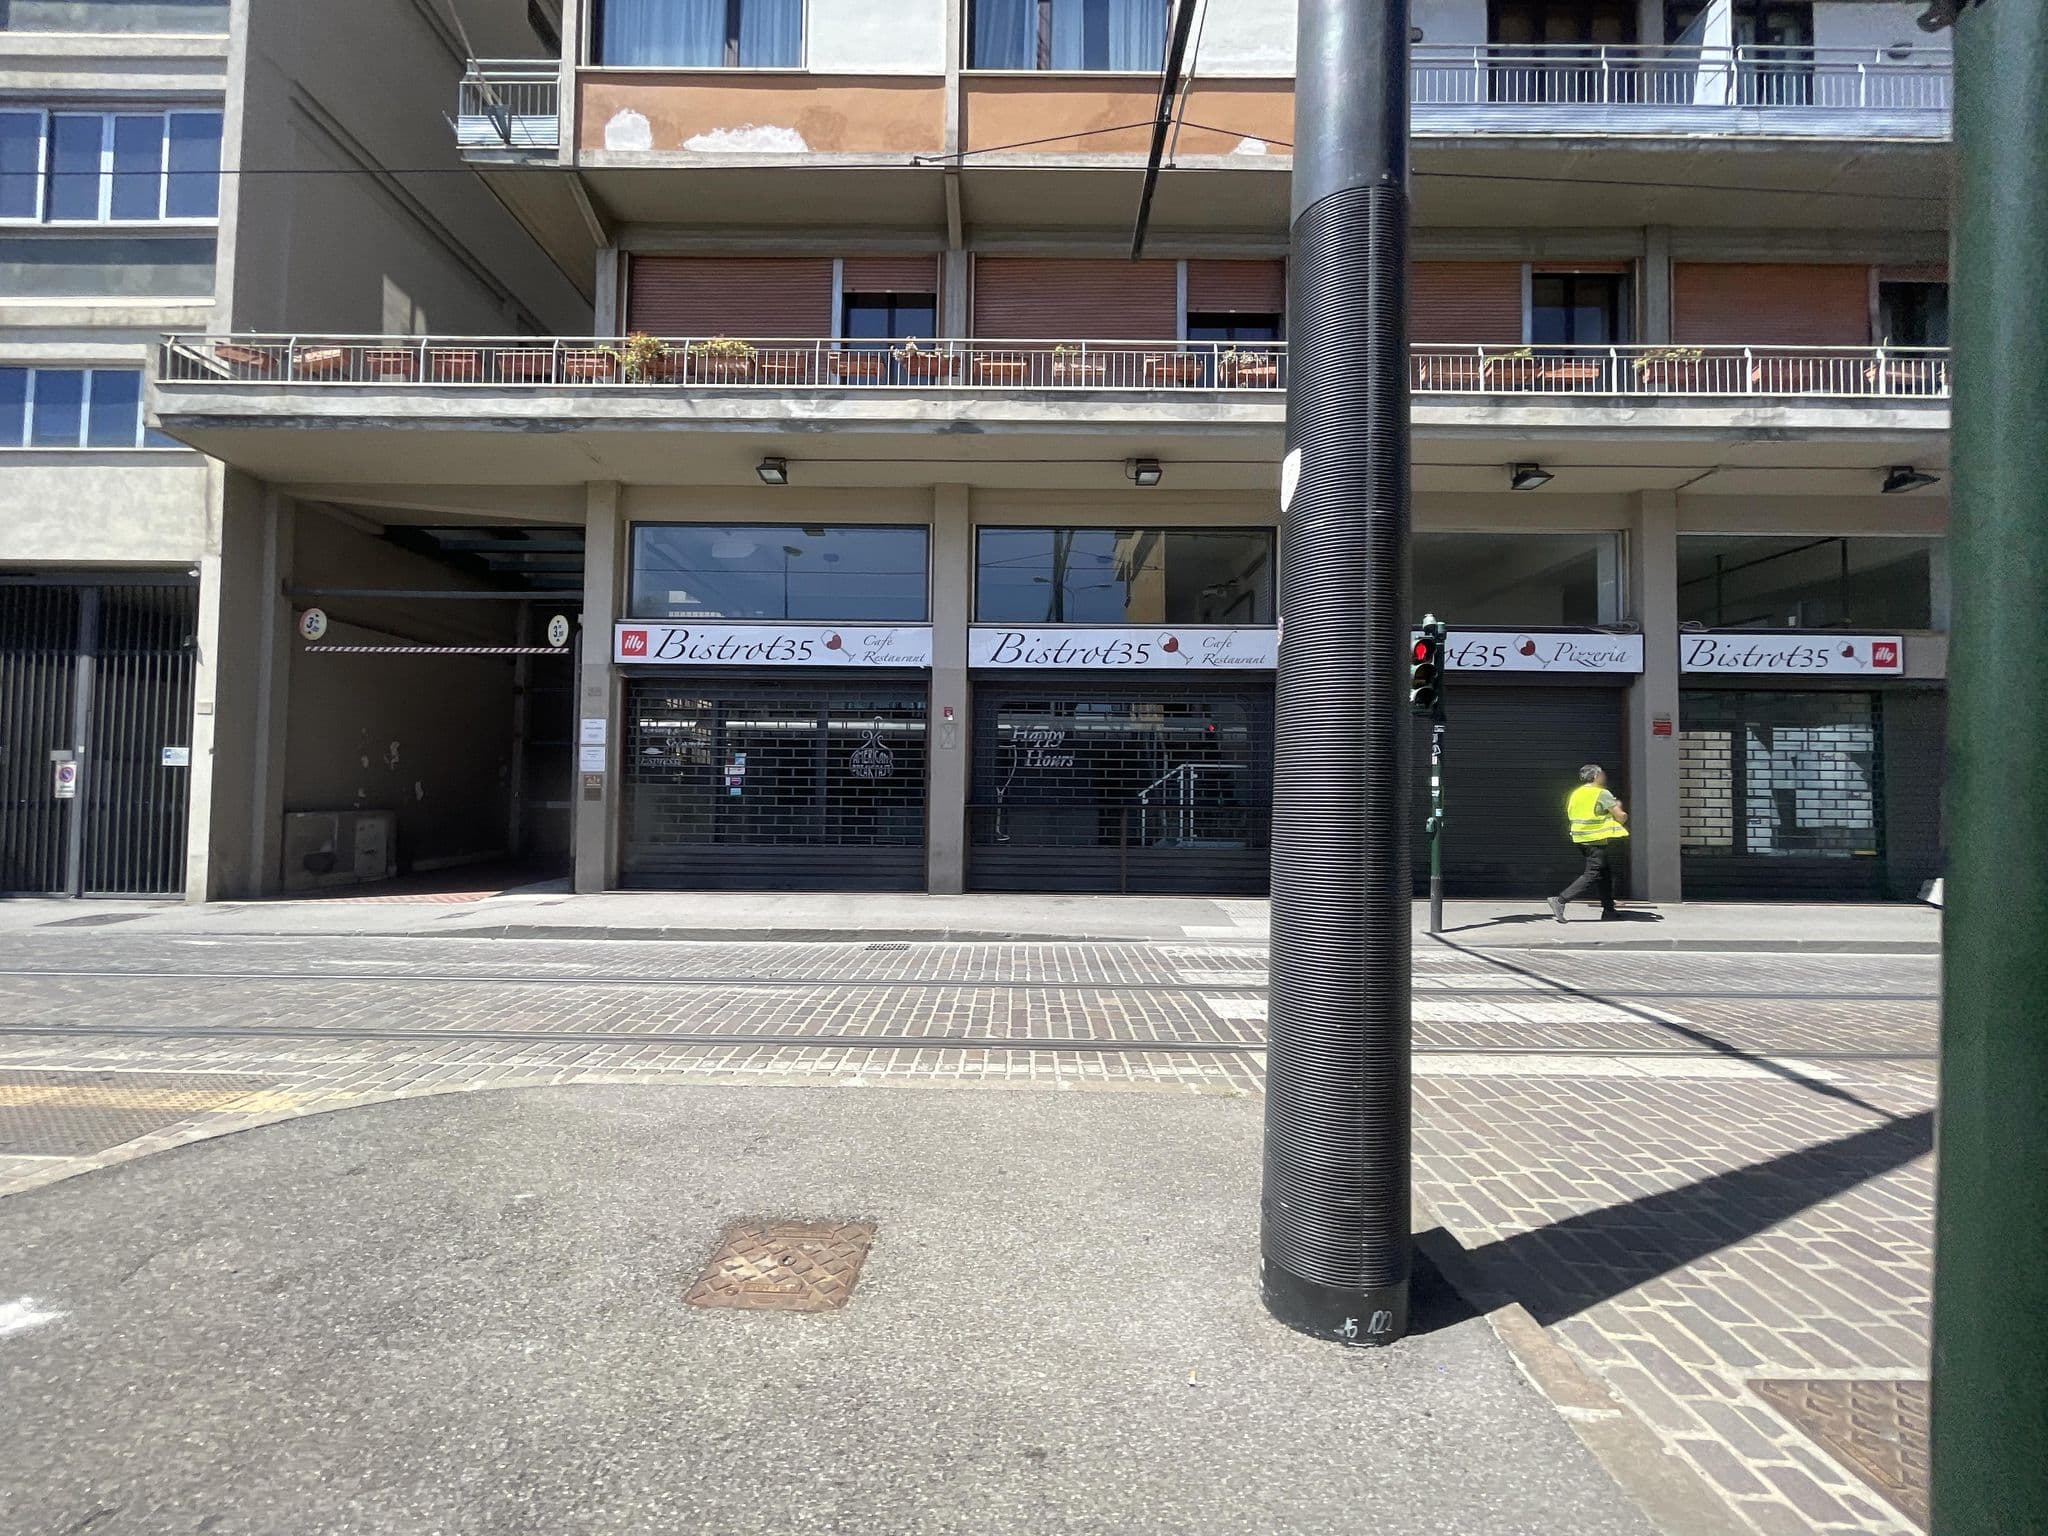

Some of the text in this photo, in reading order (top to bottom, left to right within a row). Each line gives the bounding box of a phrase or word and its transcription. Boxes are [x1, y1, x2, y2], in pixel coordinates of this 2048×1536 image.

[624, 634, 645, 653] illy
[653, 628, 814, 661] Bistrot35
[989, 632, 1151, 665] Bistrot35
[1686, 638, 1829, 668] Bistrot35
[862, 650, 926, 665] Restaurant
[1201, 652, 1266, 667] Restaurant
[1553, 641, 1628, 668] Pizzeria
[1875, 647, 1894, 664] illy
[1010, 725, 1066, 748] Happy
[1024, 749, 1075, 767] Hours
